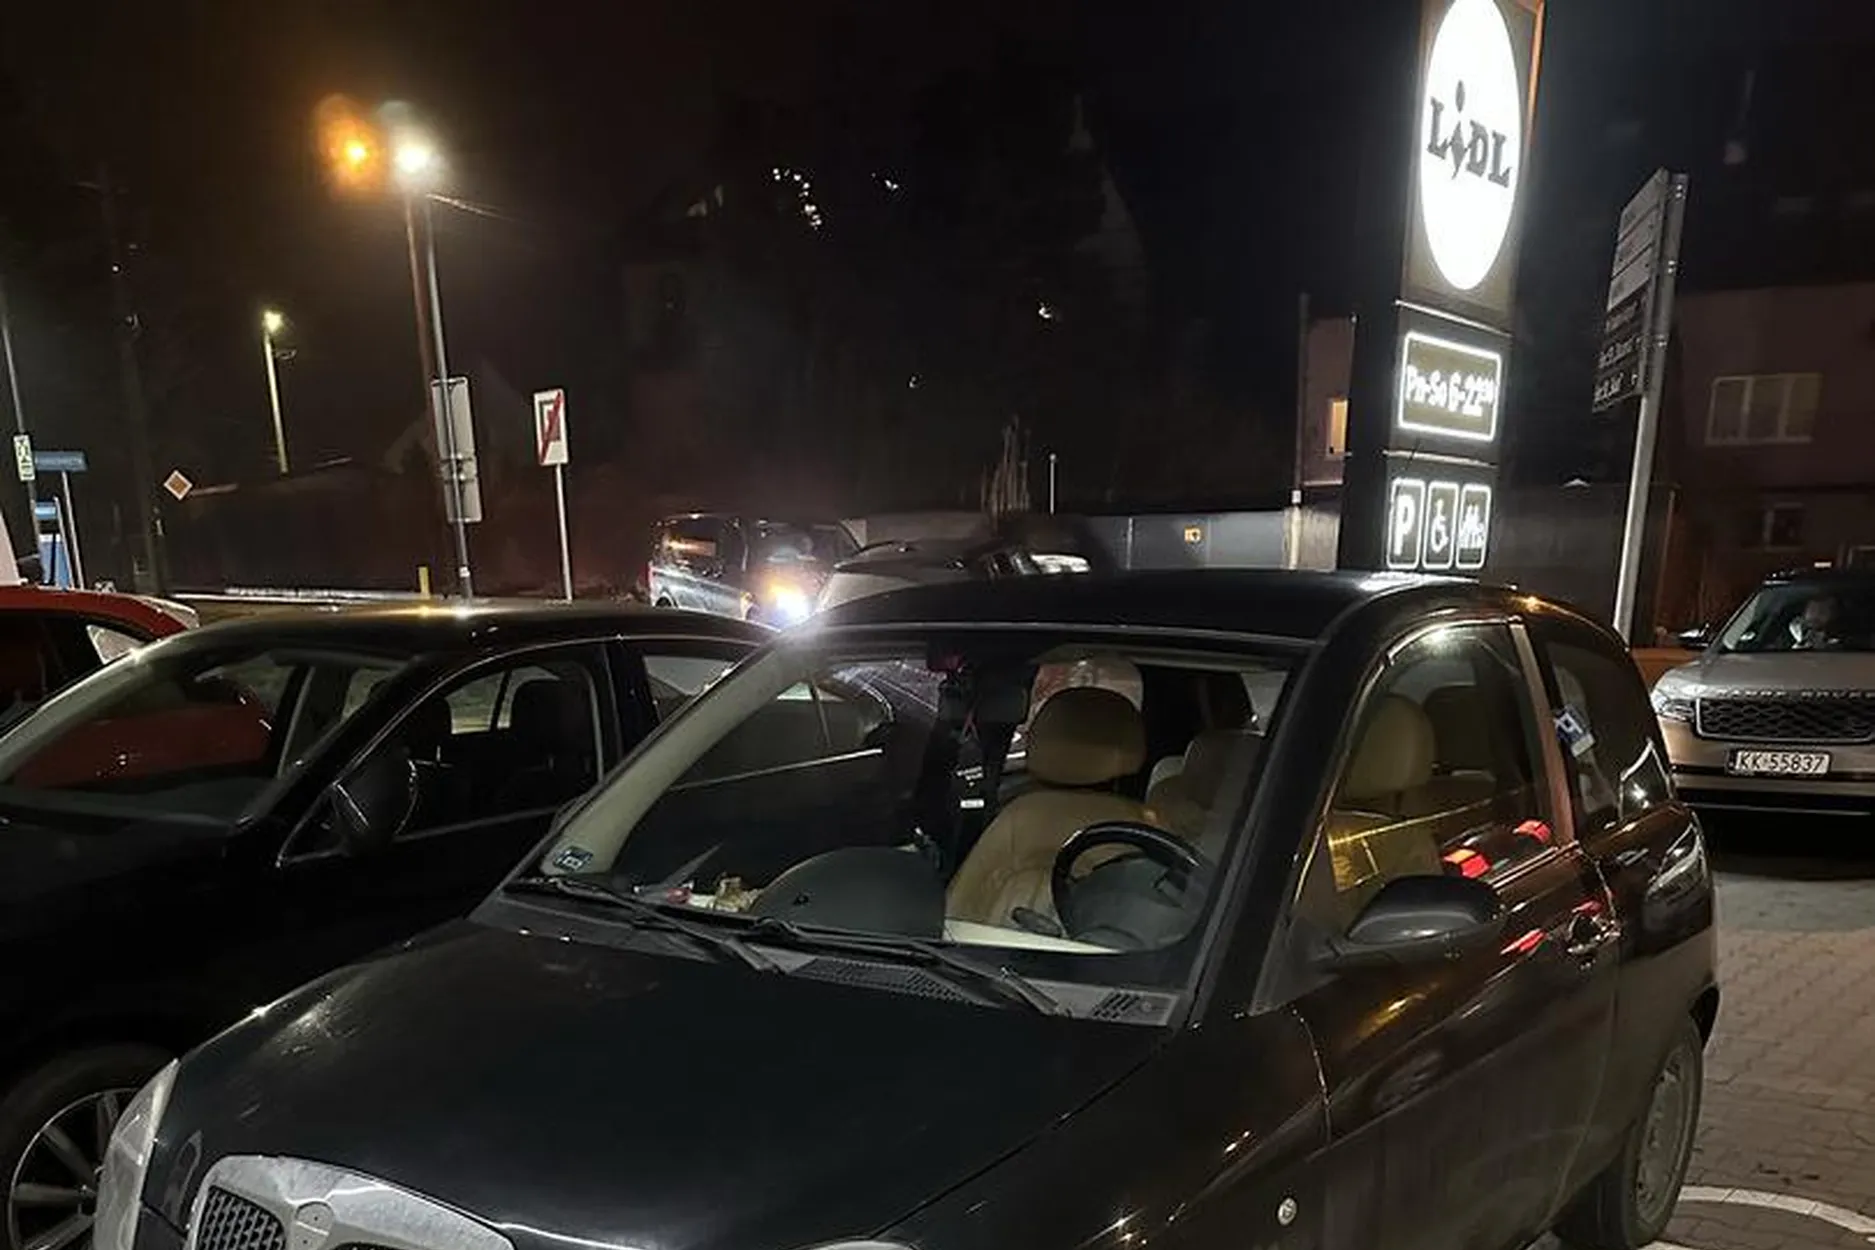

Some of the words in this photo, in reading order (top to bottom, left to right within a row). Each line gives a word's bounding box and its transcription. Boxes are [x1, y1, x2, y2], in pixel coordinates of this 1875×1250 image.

[1394, 494, 1416, 556] P
[1739, 752, 1763, 769] KK
[1769, 755, 1825, 772] 55837
